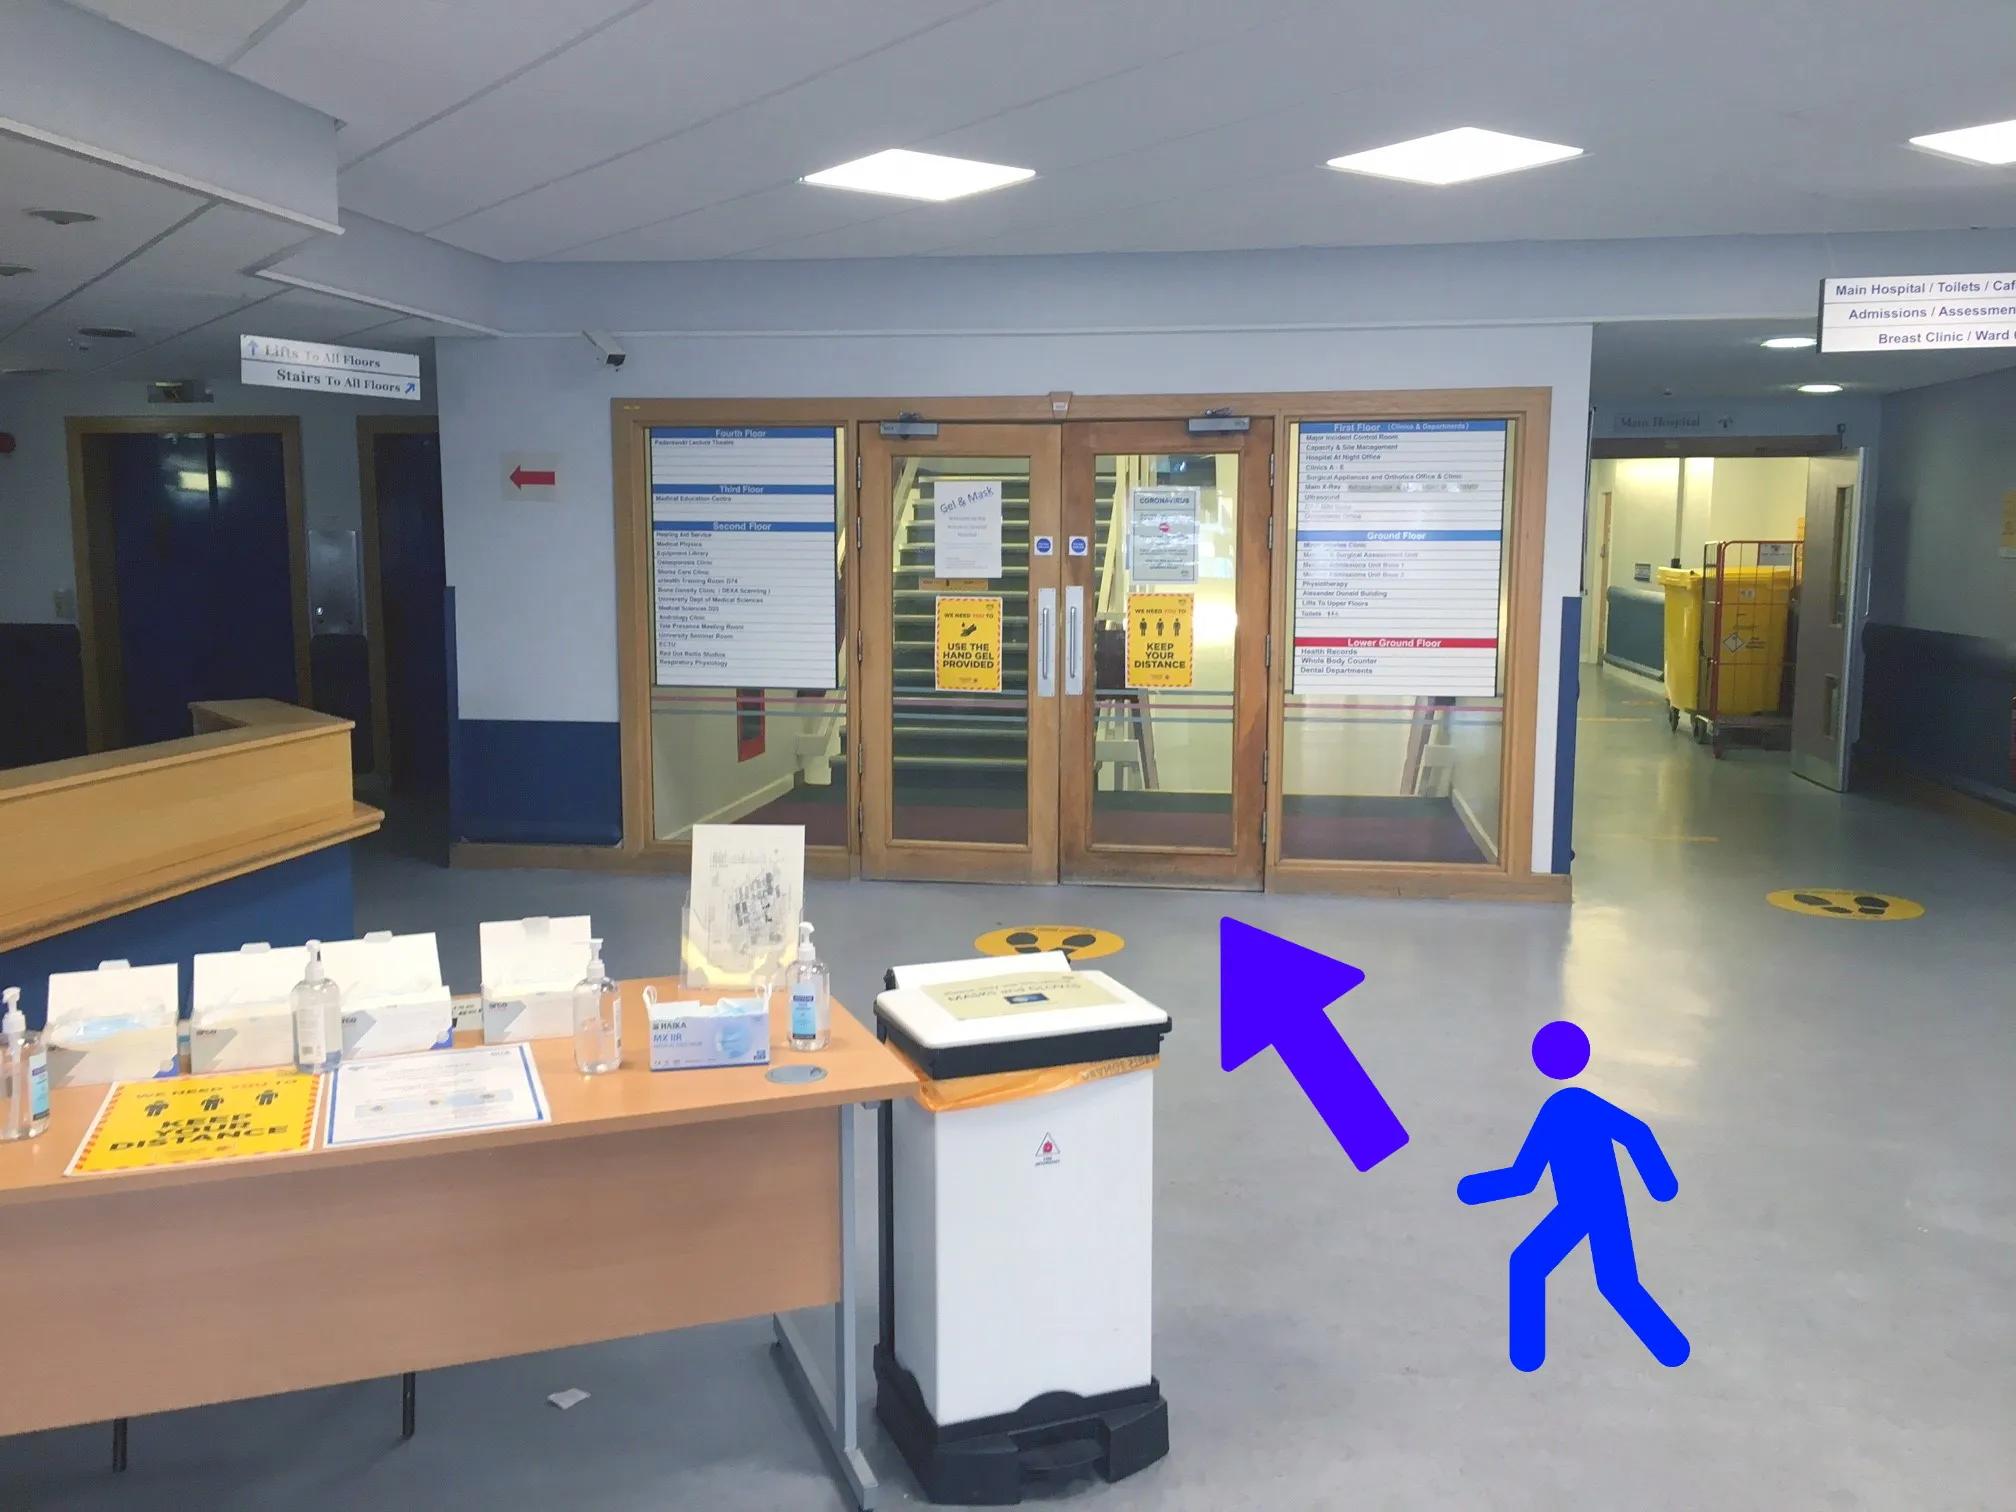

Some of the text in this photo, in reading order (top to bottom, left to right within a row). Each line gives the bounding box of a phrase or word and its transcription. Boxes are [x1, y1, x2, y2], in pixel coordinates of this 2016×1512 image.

[1835, 285, 1867, 295] Main
[1871, 283, 1925, 295] Hospital
[1938, 281, 1981, 293] Toilets
[1848, 308, 1927, 320] Admissions
[1878, 333, 1922, 344] Breast
[1926, 331, 1964, 342] Clinic
[1975, 330, 2010, 341] Ward
[265, 345, 381, 368] Lifts To All Floors
[277, 369, 401, 392] Stairs To All Floors
[1621, 415, 1700, 429] Main Hospital
[1333, 424, 1354, 432] First
[1356, 424, 1381, 432] Floor
[715, 429, 766, 437] Fourth Floor
[1305, 434, 1323, 442] Major
[1353, 433, 1377, 441] Control
[1305, 444, 1334, 452] Capacity
[1356, 443, 1398, 451] Management
[1305, 454, 1332, 462] Hospital
[1361, 453, 1380, 461] Office
[1306, 474, 1333, 482] Surgical
[1333, 474, 1369, 482] Appliances
[1443, 472, 1462, 480] Clinic
[719, 485, 764, 494] Third Floor
[940, 486, 994, 513] Gel & Mask
[1139, 496, 1190, 504] CORONAVIRUS
[749, 523, 772, 531] Floor
[1366, 532, 1426, 540] Ground Floor
[947, 642, 990, 651] USE THE
[1147, 642, 1174, 651] KEEP
[1347, 639, 1442, 648] Lower Ground Floor
[943, 651, 994, 661] HAND GEL
[1145, 651, 1174, 660] YOUR
[943, 660, 994, 669] PROVIDED
[1134, 660, 1186, 669] DISTANCE
[1326, 658, 1345, 666] Body
[1326, 667, 1373, 675] Departments
[653, 1033, 667, 1042] MX
[172, 1087, 224, 1096] NEED
[161, 1113, 253, 1130] KEEP
[156, 1121, 252, 1138] YOUR
[109, 1125, 289, 1151] DISTANCE
